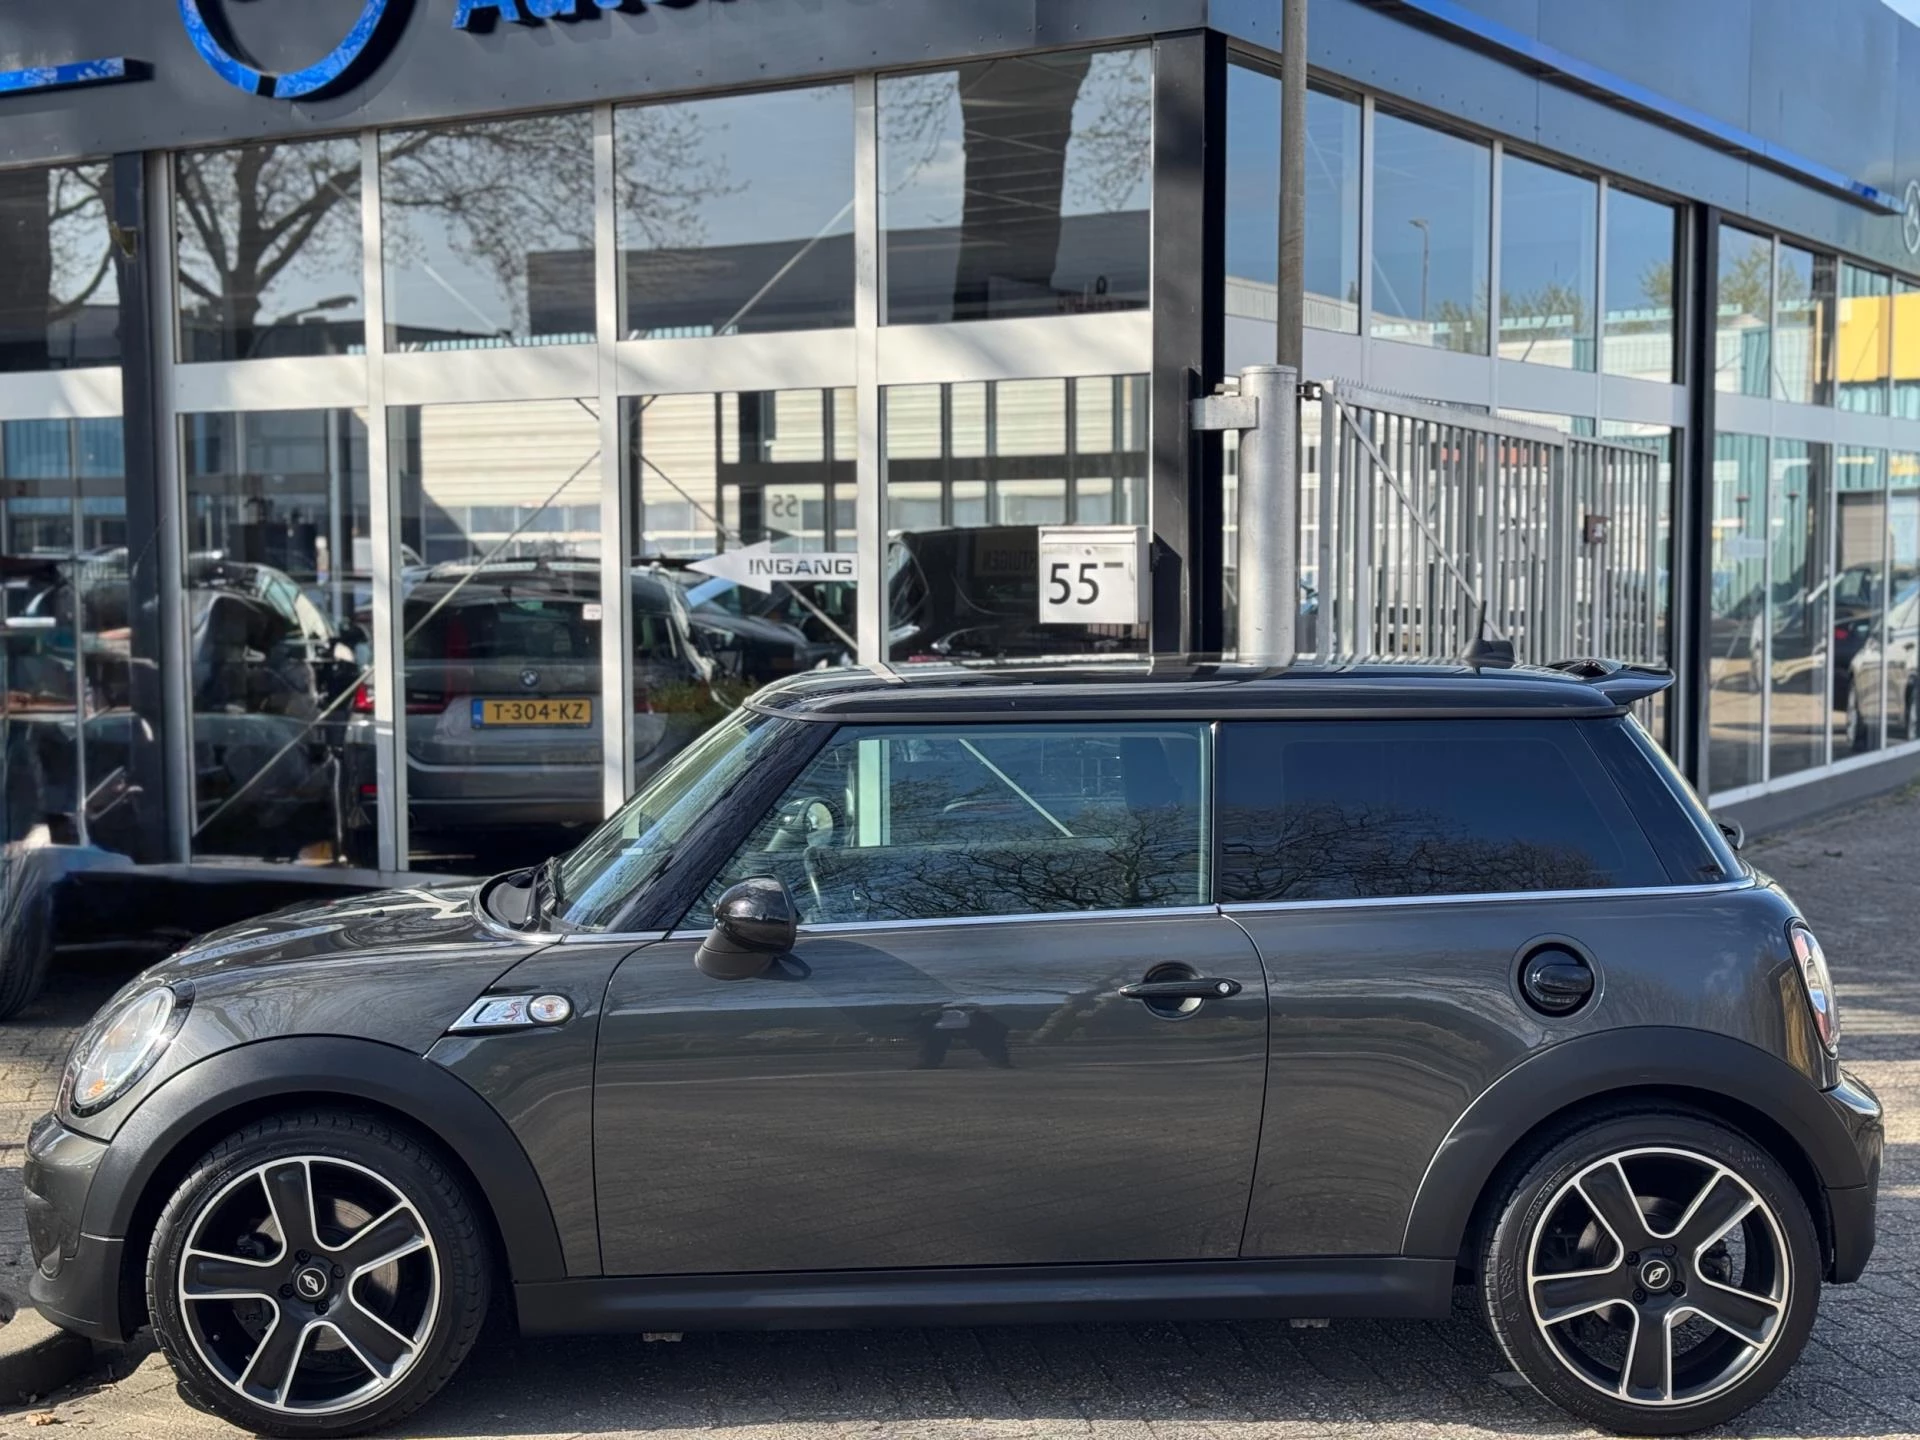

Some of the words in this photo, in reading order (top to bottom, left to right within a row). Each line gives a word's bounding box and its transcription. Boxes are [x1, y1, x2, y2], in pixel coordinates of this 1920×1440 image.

[748, 559, 853, 575] INGANG
[1048, 563, 1100, 605] 55
[493, 703, 584, 720] T-304-KZ
